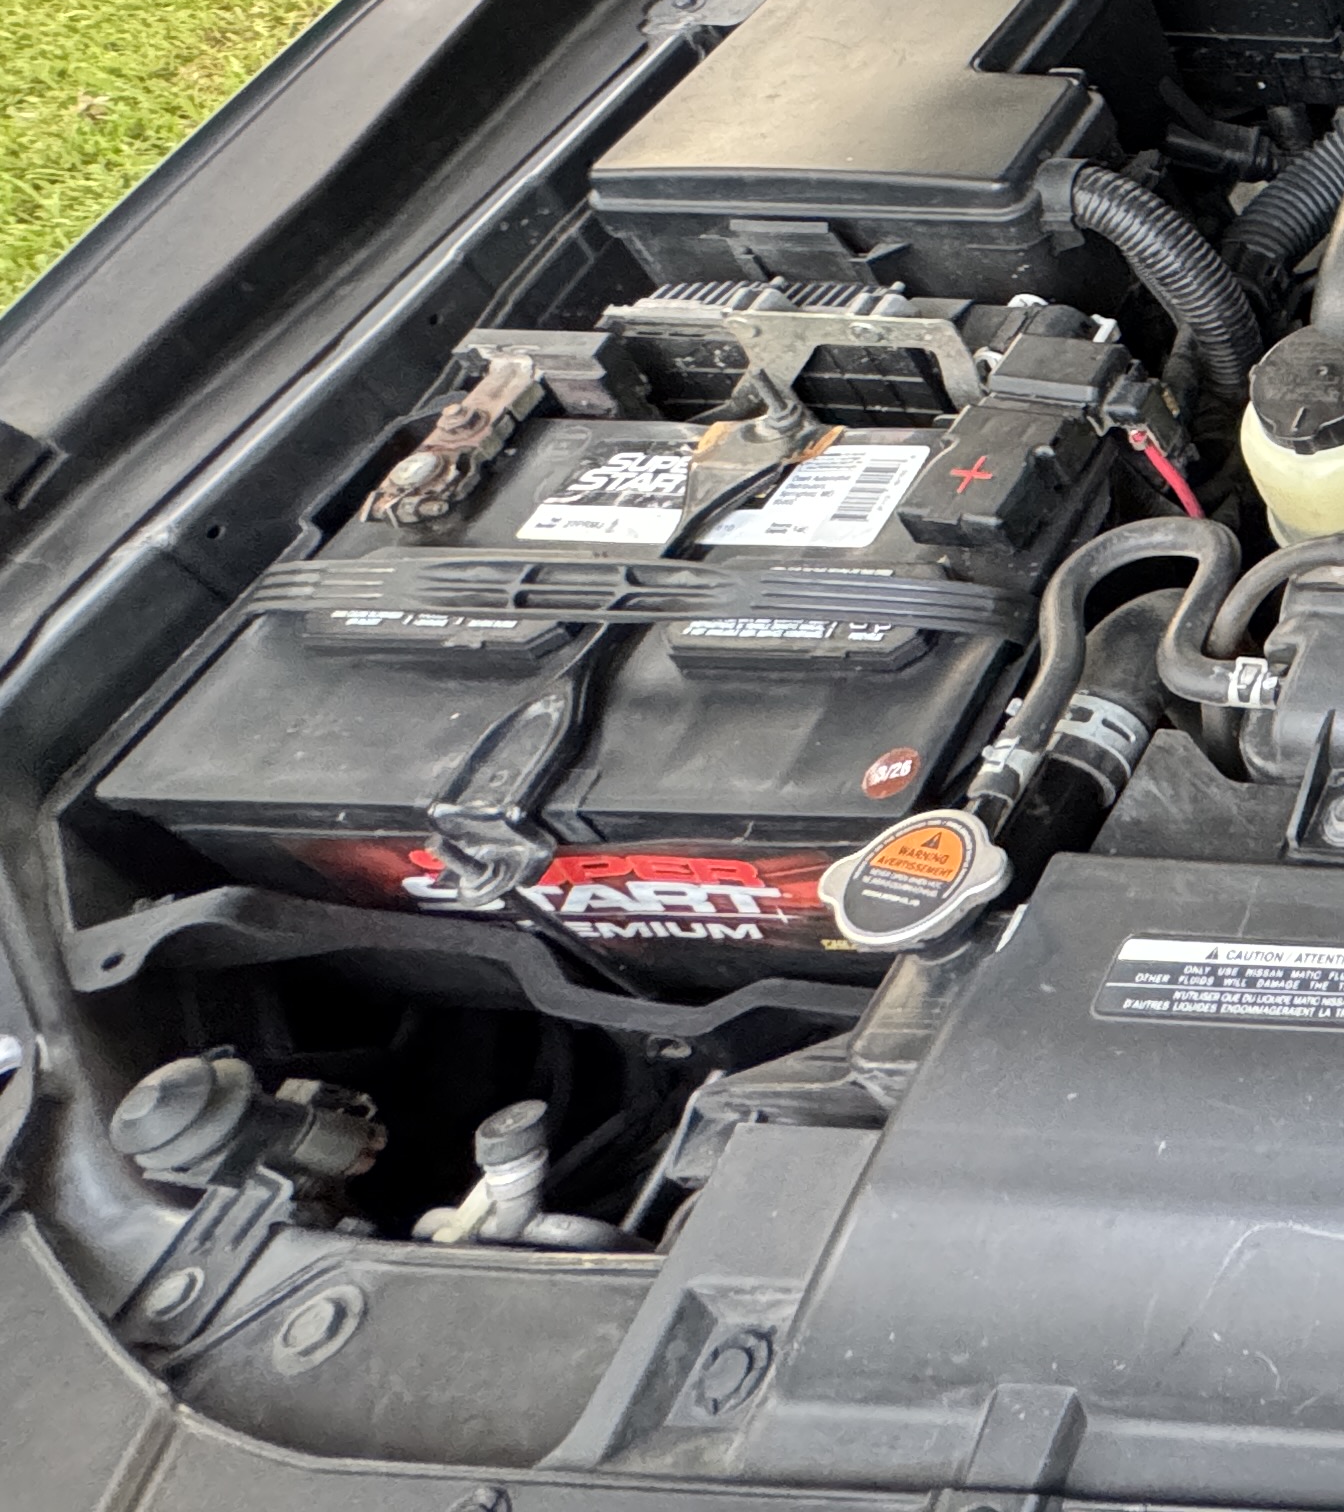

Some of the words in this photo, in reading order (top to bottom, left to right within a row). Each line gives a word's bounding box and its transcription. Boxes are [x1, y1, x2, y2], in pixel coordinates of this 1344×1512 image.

[600, 452, 692, 473] SUPE
[566, 468, 686, 494] STAR
[898, 845, 950, 865] WARNING
[877, 855, 953, 877] AVERTISSEMENT
[1226, 949, 1284, 963] CAUTION
[1135, 972, 1171, 983] OTHER
[1178, 975, 1215, 986] FLUIDS
[1223, 977, 1247, 987] WILL
[1256, 979, 1300, 989] DAMAGE
[1309, 981, 1329, 991] THE
[1184, 965, 1211, 975] ONLY
[1217, 967, 1240, 976] USE
[1245, 968, 1284, 978] NISSAN
[1290, 969, 1321, 980] MATIC
[1122, 998, 1170, 1011] D'AUTRES
[1172, 1002, 1217, 1013] LIQUIDES
[1318, 1008, 1331, 1018] LA
[1293, 996, 1320, 1006] MATIC
